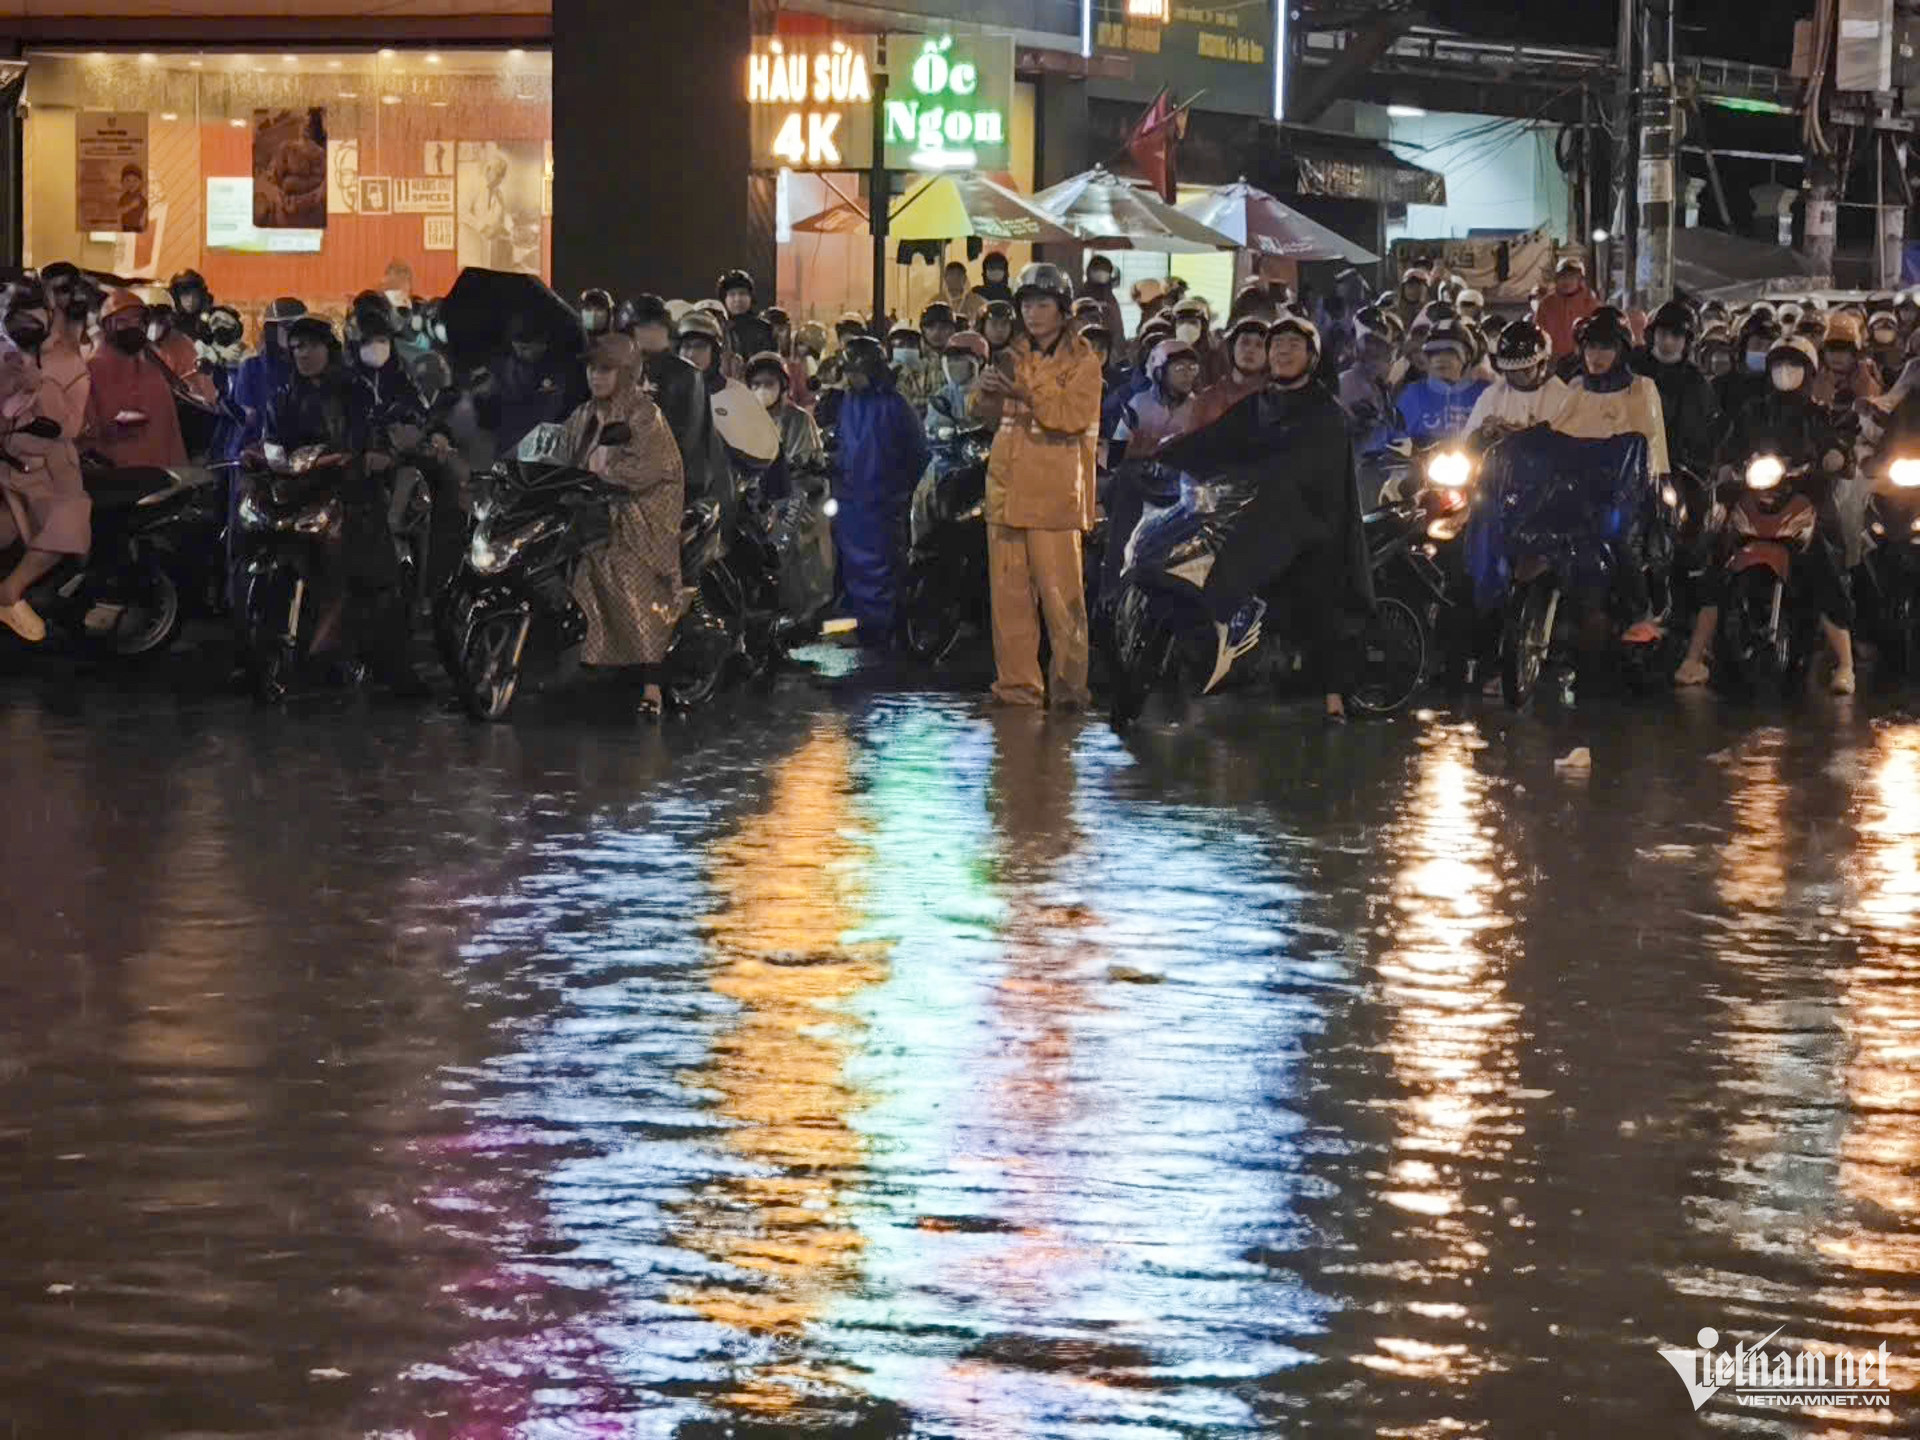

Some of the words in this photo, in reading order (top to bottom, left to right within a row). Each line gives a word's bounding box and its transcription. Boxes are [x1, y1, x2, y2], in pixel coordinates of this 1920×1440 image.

[912, 35, 978, 95] Ốc
[772, 112, 842, 164] 4K
[884, 100, 1004, 151] Ngon
[412, 192, 450, 203] SPICES
